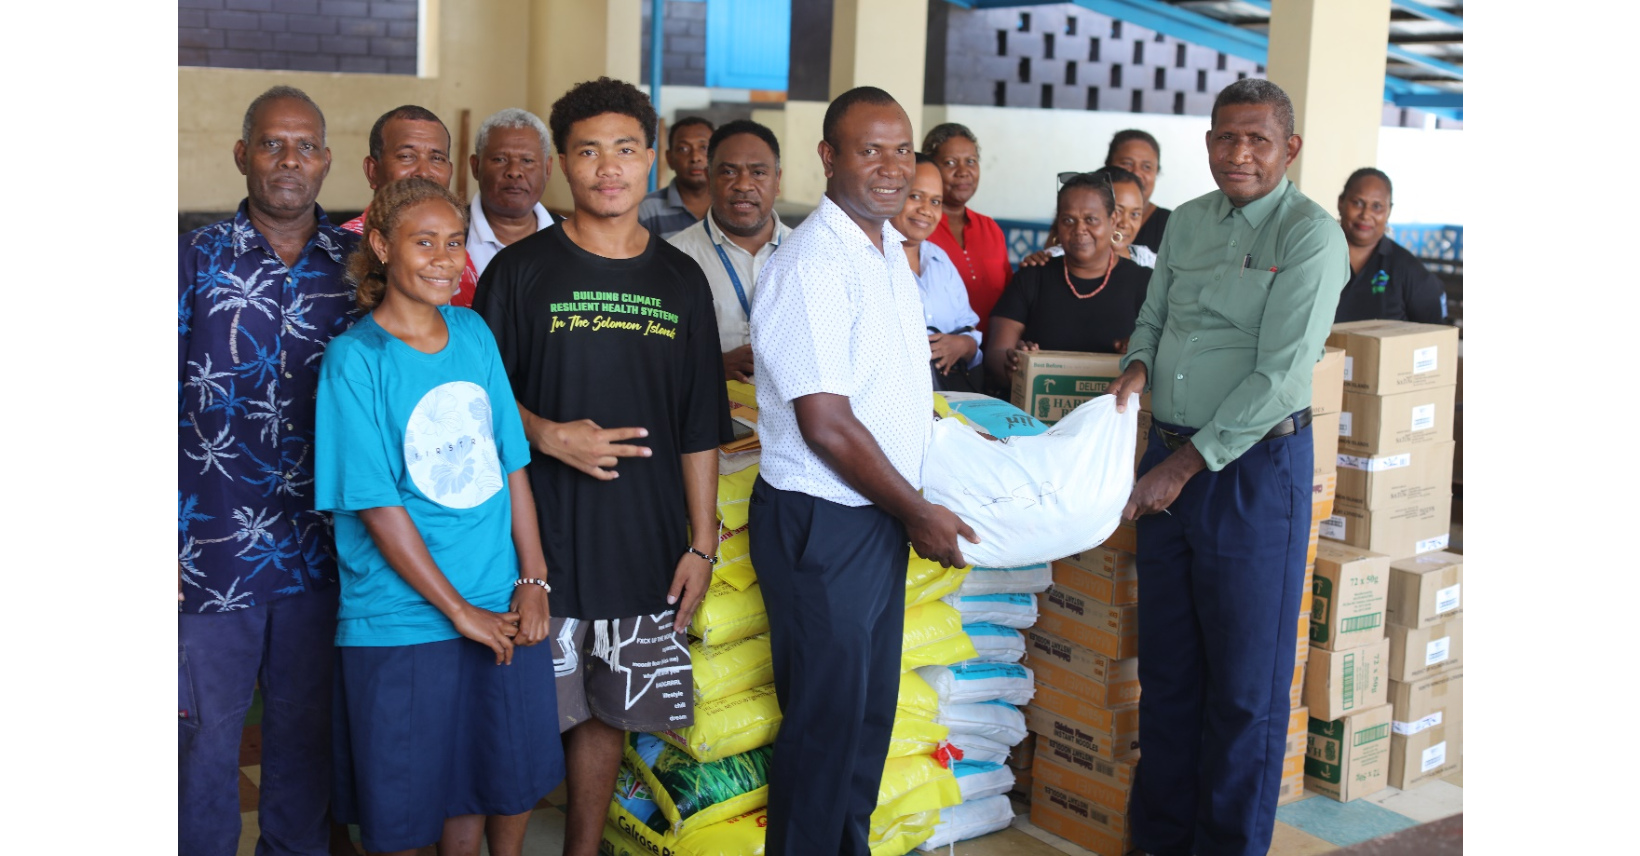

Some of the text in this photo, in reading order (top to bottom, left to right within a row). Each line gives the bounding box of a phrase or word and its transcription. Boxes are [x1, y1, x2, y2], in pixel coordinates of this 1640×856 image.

[573, 291, 662, 308] BUILDING CLIMATE
[550, 302, 600, 313] RESILIENT
[601, 303, 639, 315] HEALTH
[550, 315, 566, 333] In
[568, 315, 590, 331] The
[592, 315, 642, 332] Solomon
[1079, 382, 1107, 392] DELITE
[1053, 728, 1099, 752] INSTANT NOODLES
[618, 815, 660, 856] Calrose
